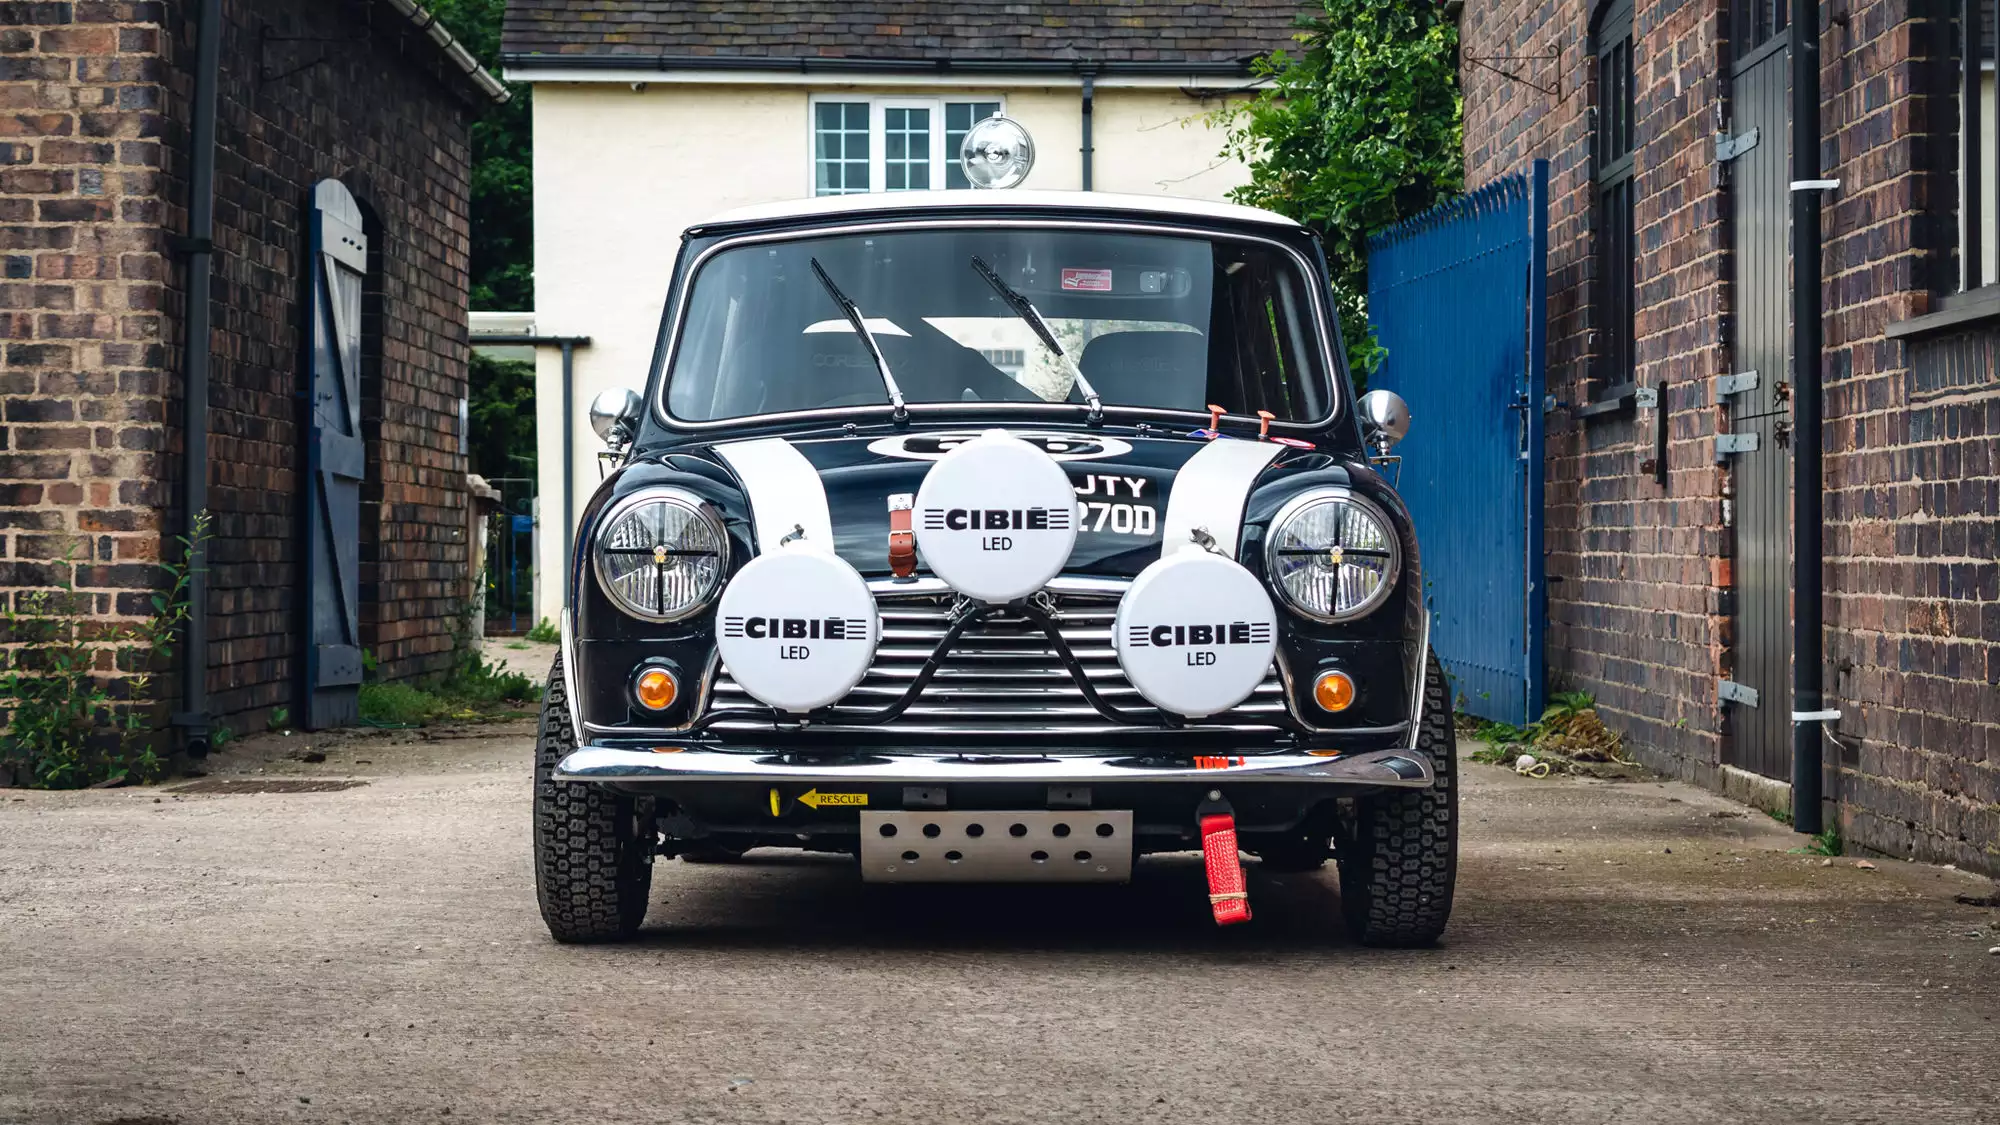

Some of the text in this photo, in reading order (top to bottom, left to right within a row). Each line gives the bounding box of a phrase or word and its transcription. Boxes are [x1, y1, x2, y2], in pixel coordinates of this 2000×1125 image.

[1073, 474, 1147, 498] JTY
[982, 536, 1013, 551] LED
[780, 645, 810, 660] LED
[1186, 651, 1217, 666] LED
[1192, 755, 1230, 770] TOW
[820, 795, 863, 804] RESCUE
